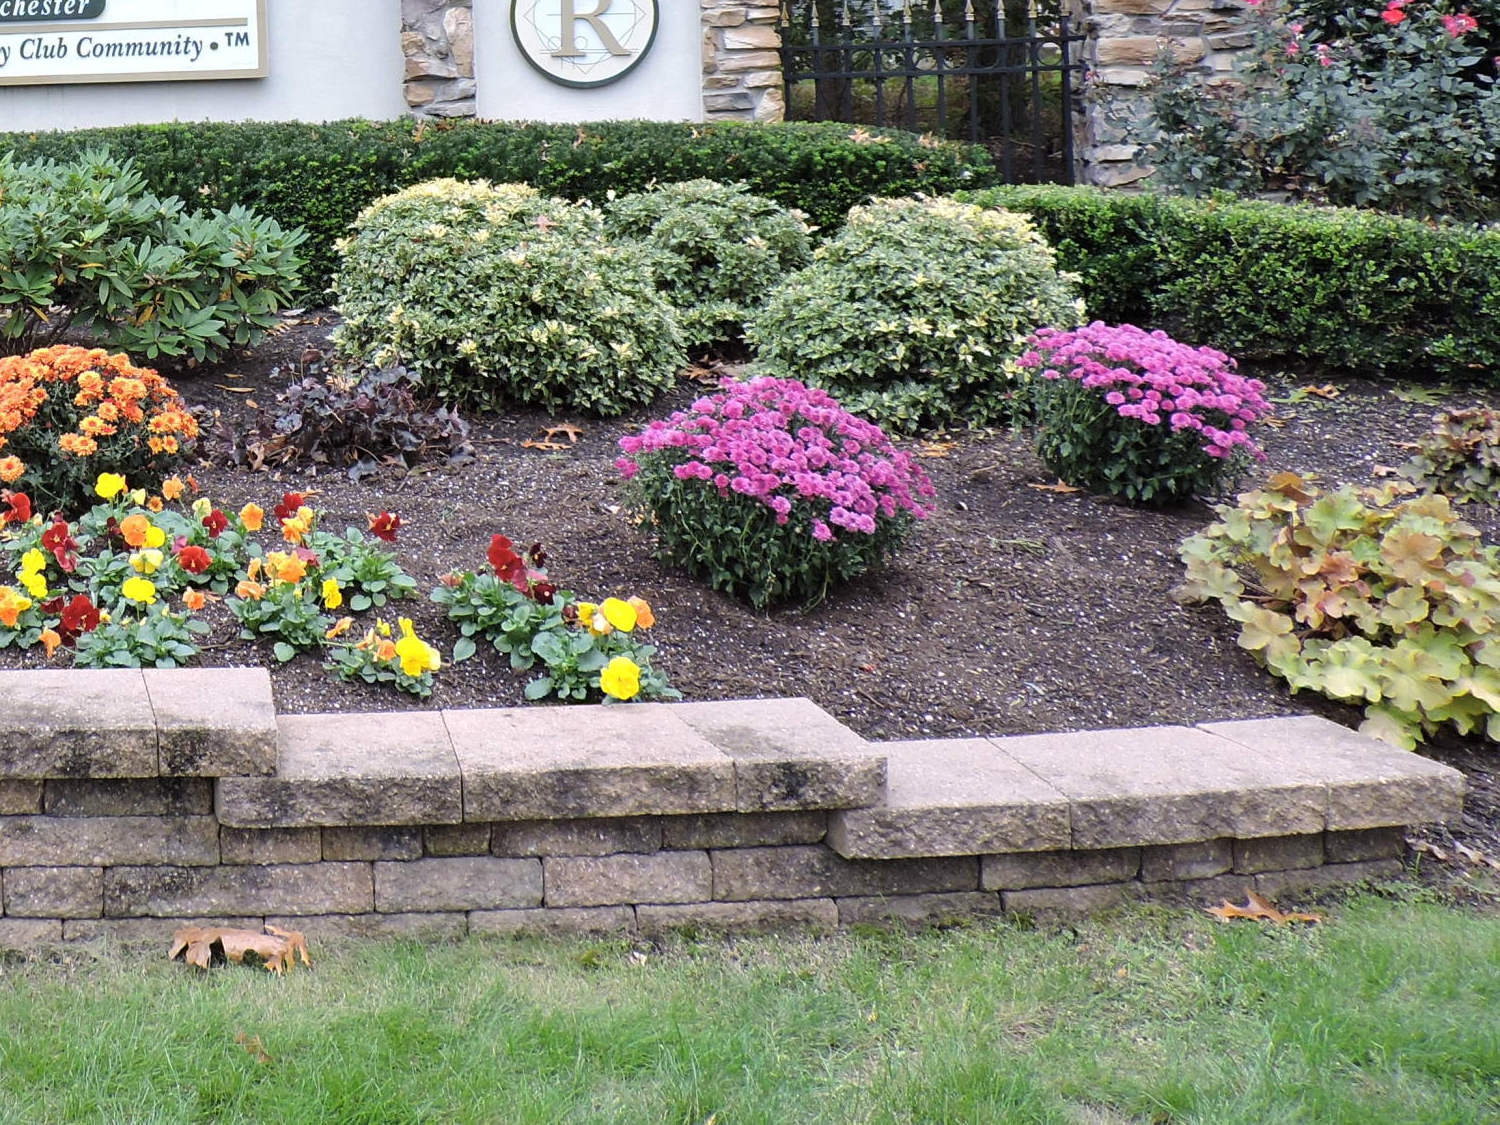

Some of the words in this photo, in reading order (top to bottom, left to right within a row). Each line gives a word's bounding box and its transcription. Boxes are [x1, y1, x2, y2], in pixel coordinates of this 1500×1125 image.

[19, 36, 68, 60] Club
[76, 33, 203, 63] Community
[224, 31, 251, 47] TM
